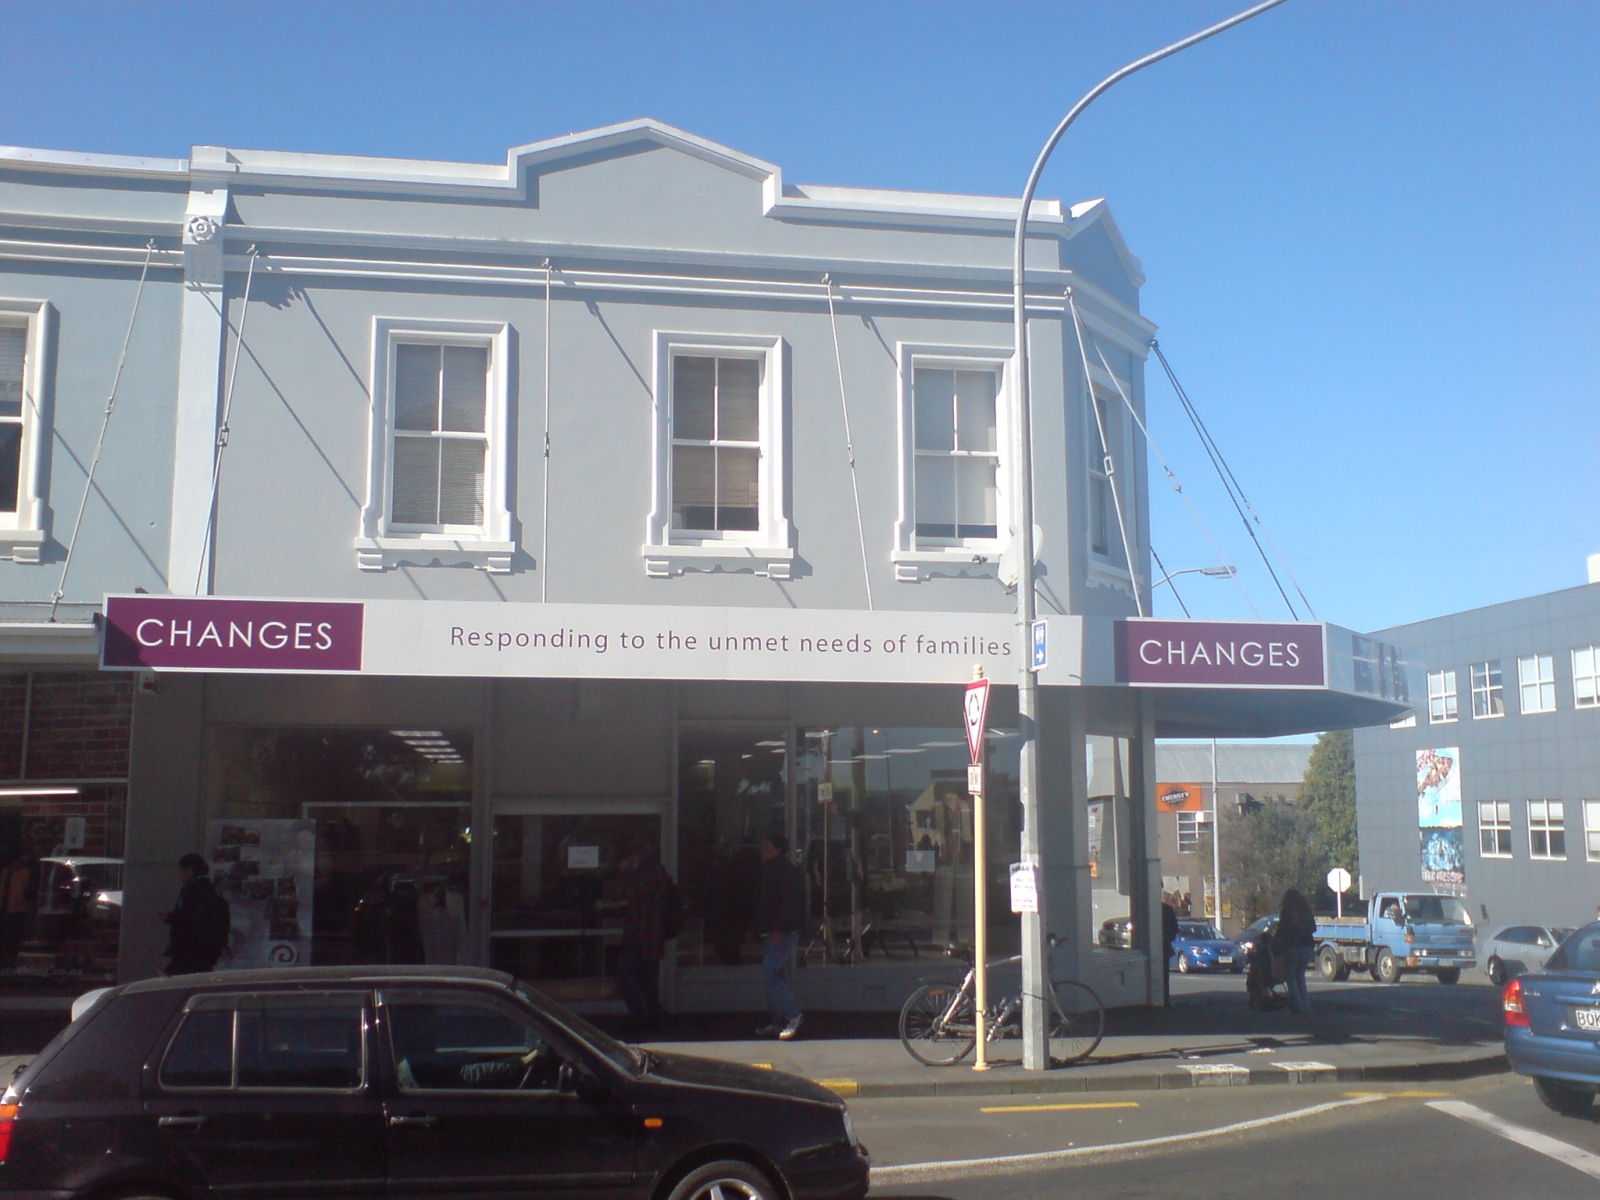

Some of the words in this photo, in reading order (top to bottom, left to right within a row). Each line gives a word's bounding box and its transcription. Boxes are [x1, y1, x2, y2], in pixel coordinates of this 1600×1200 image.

[136, 618, 332, 650] CHANGES
[451, 626, 608, 653] Responding
[620, 632, 645, 649] to
[656, 630, 697, 650] the
[709, 634, 789, 652] unmet
[800, 634, 872, 653] needs
[883, 634, 907, 653] of
[916, 635, 1011, 656] families
[1139, 639, 1300, 667] CHANGES
